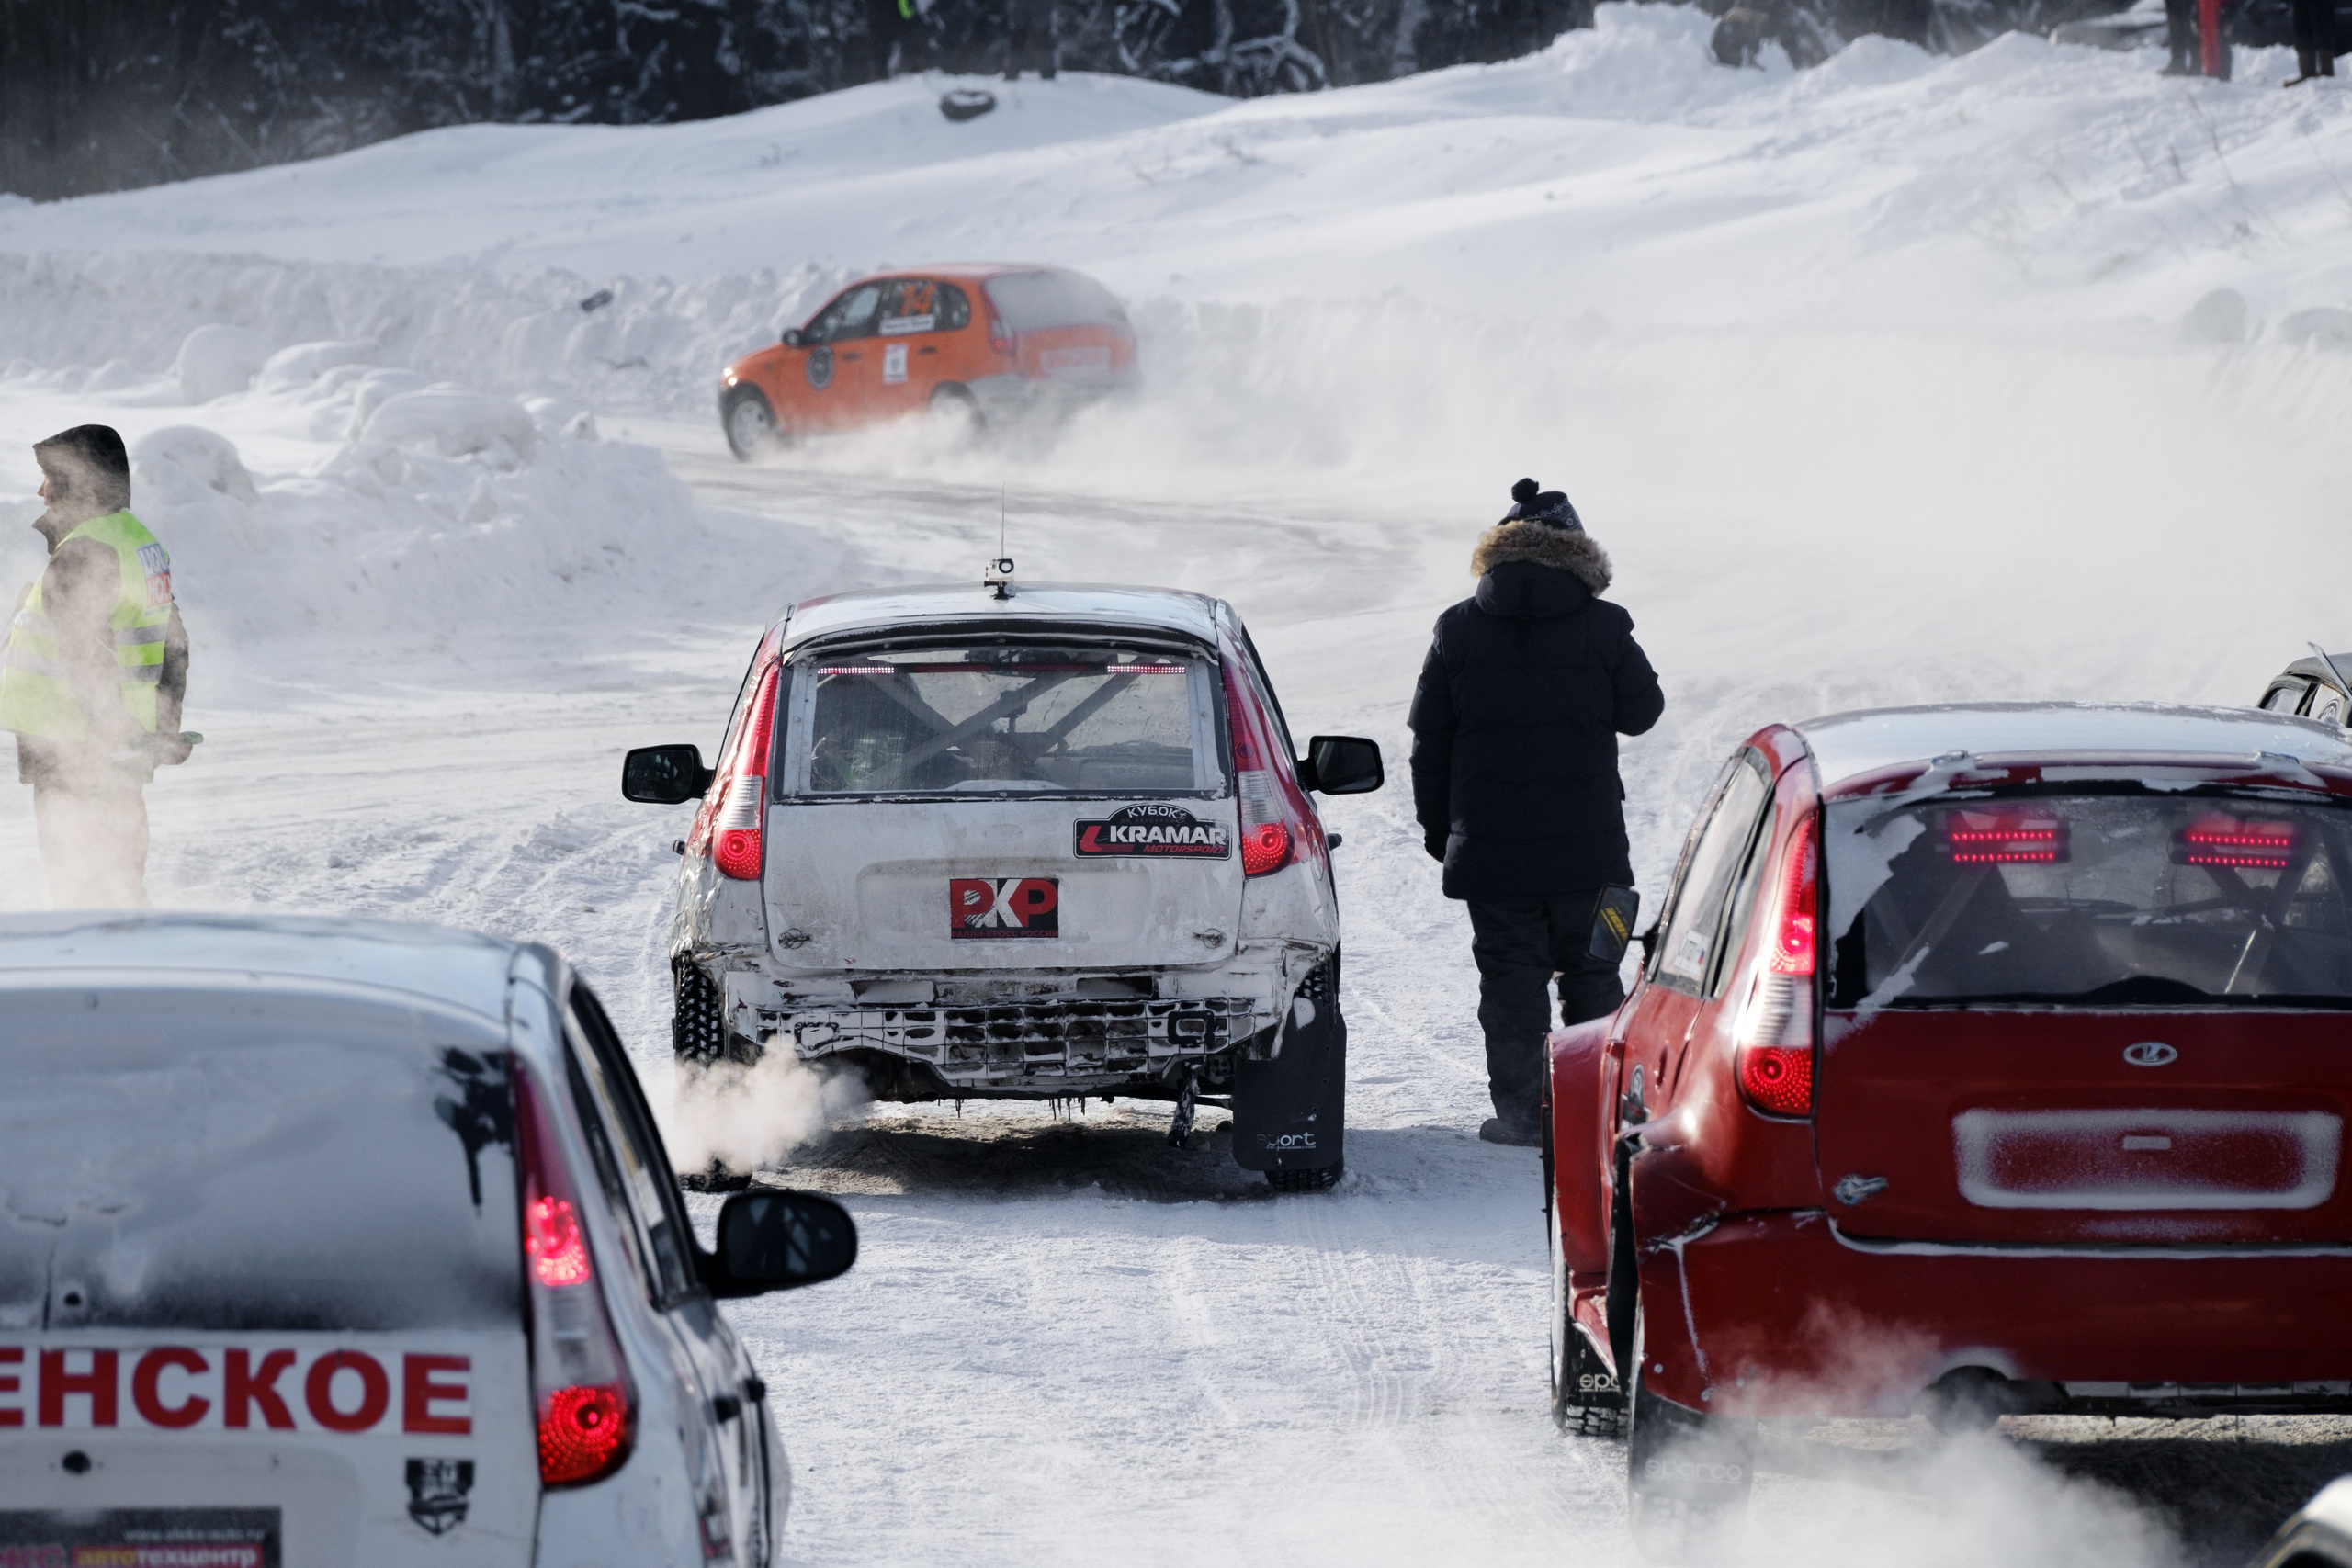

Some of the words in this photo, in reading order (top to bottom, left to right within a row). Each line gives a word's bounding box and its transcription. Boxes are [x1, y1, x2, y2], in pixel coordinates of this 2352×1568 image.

[1127, 806, 1180, 818] КУБОК
[1110, 825, 1227, 845] KRAMAR
[1143, 844, 1226, 854] MOTORSPORT
